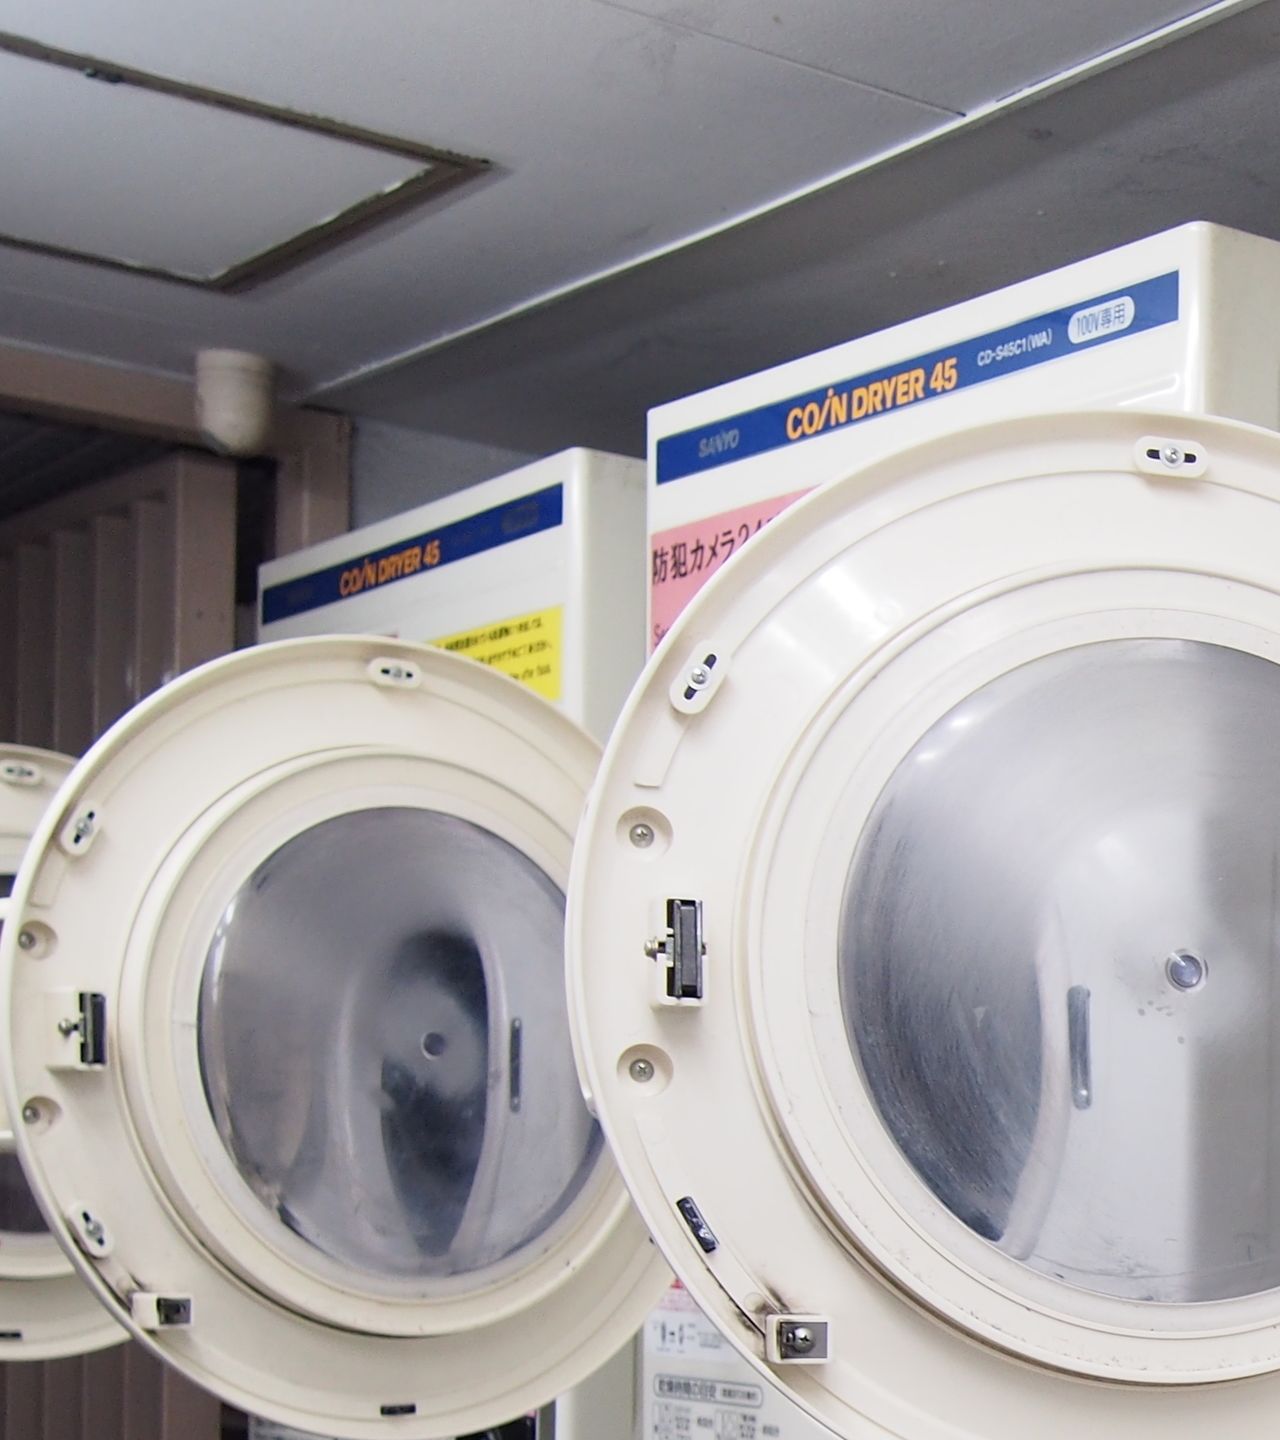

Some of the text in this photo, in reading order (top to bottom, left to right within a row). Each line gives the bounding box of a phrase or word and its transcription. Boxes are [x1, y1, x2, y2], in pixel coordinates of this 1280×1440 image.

[698, 428, 740, 459] SANYO
[851, 369, 926, 418] DRYER
[930, 357, 959, 391] 45
